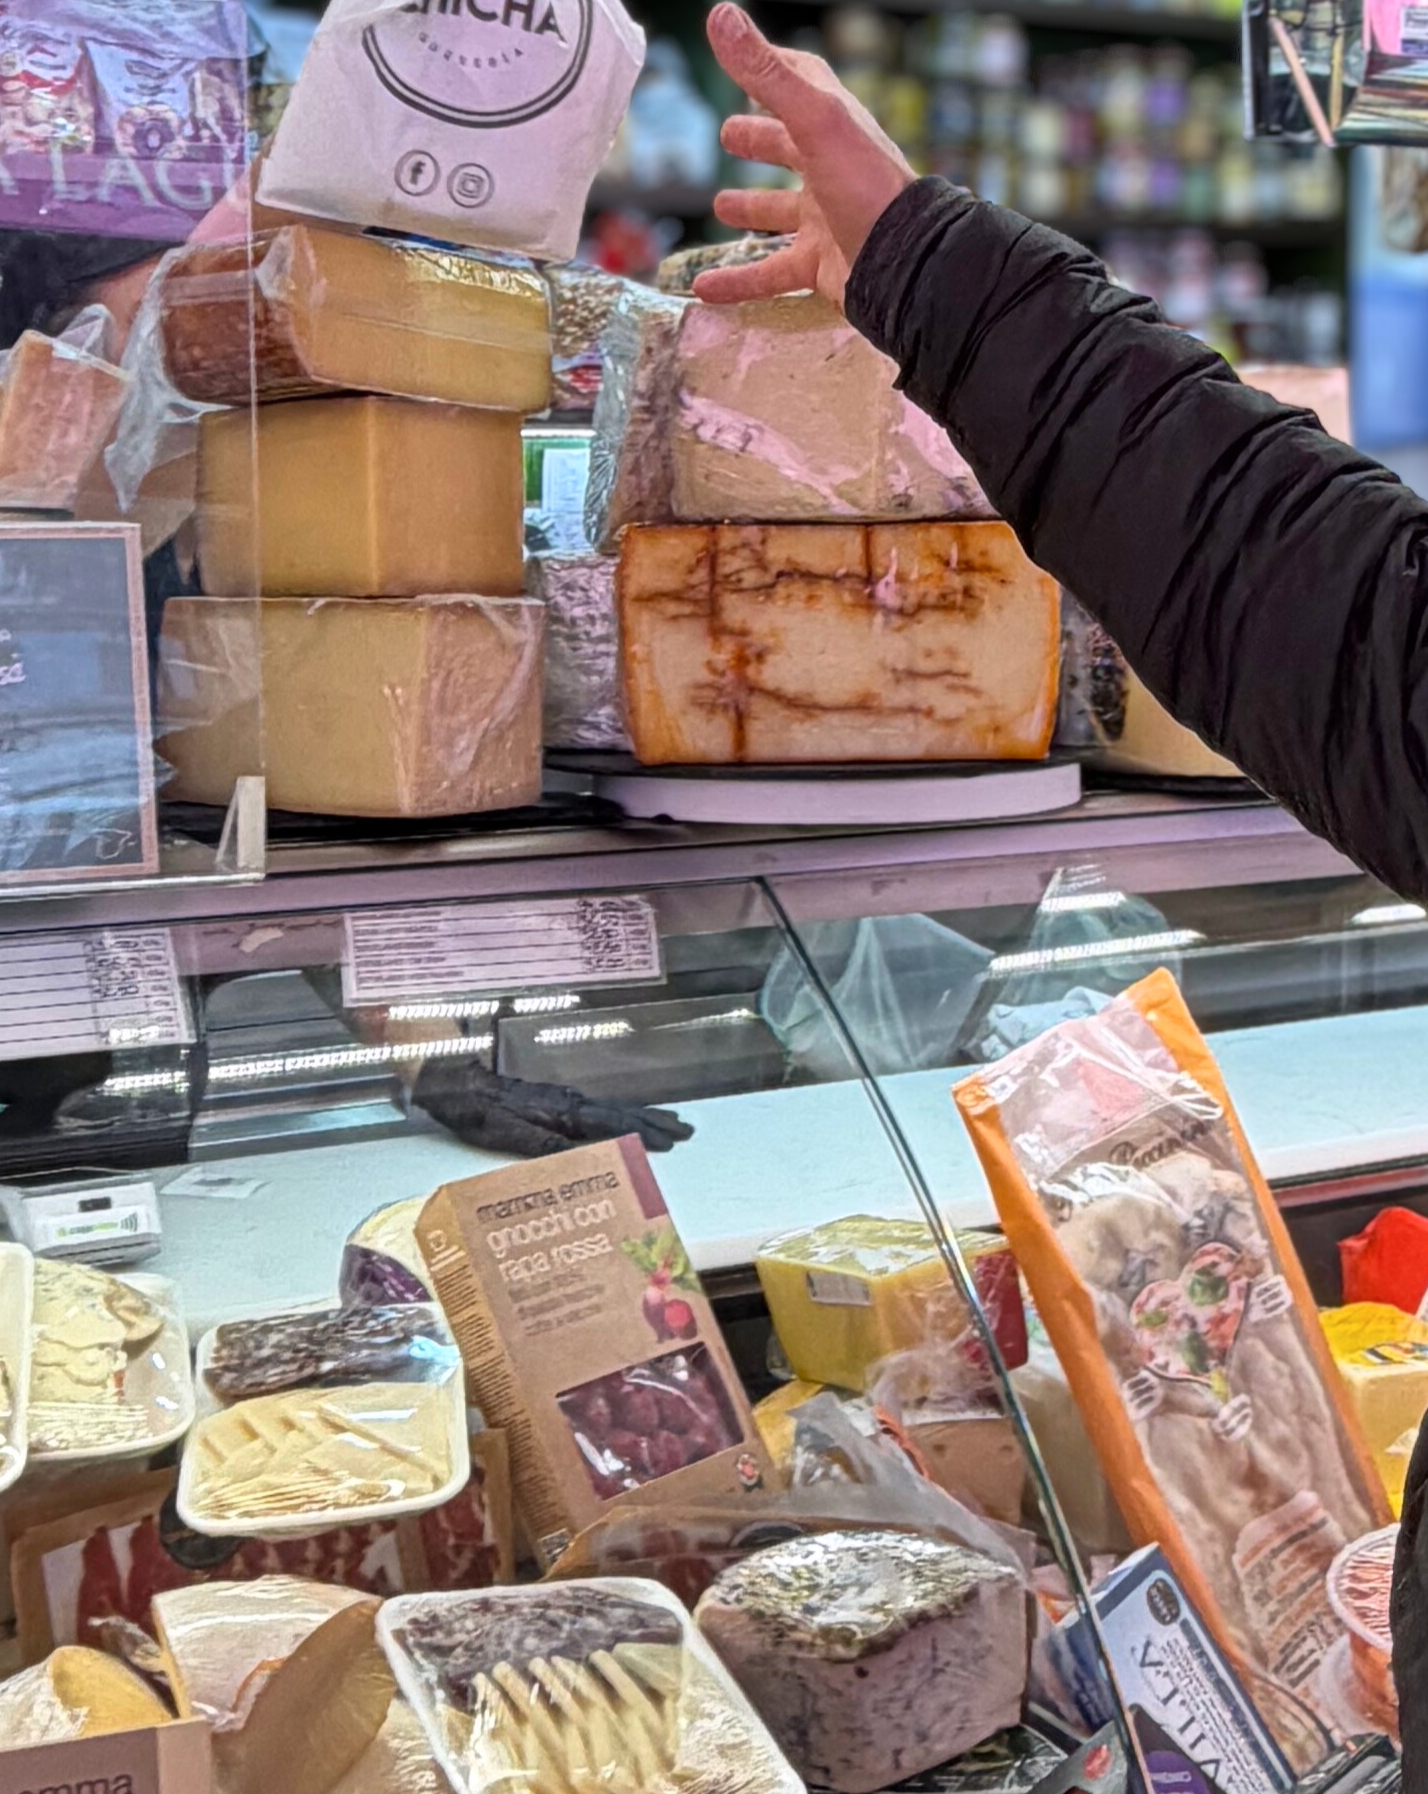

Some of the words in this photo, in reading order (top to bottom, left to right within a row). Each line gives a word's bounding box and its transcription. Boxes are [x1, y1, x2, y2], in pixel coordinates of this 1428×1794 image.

[476, 1186, 556, 1222] mamma
[559, 1169, 620, 1202] emma
[486, 1209, 571, 1259] gnocchi
[572, 1197, 618, 1228] con
[497, 1249, 551, 1284] rapa
